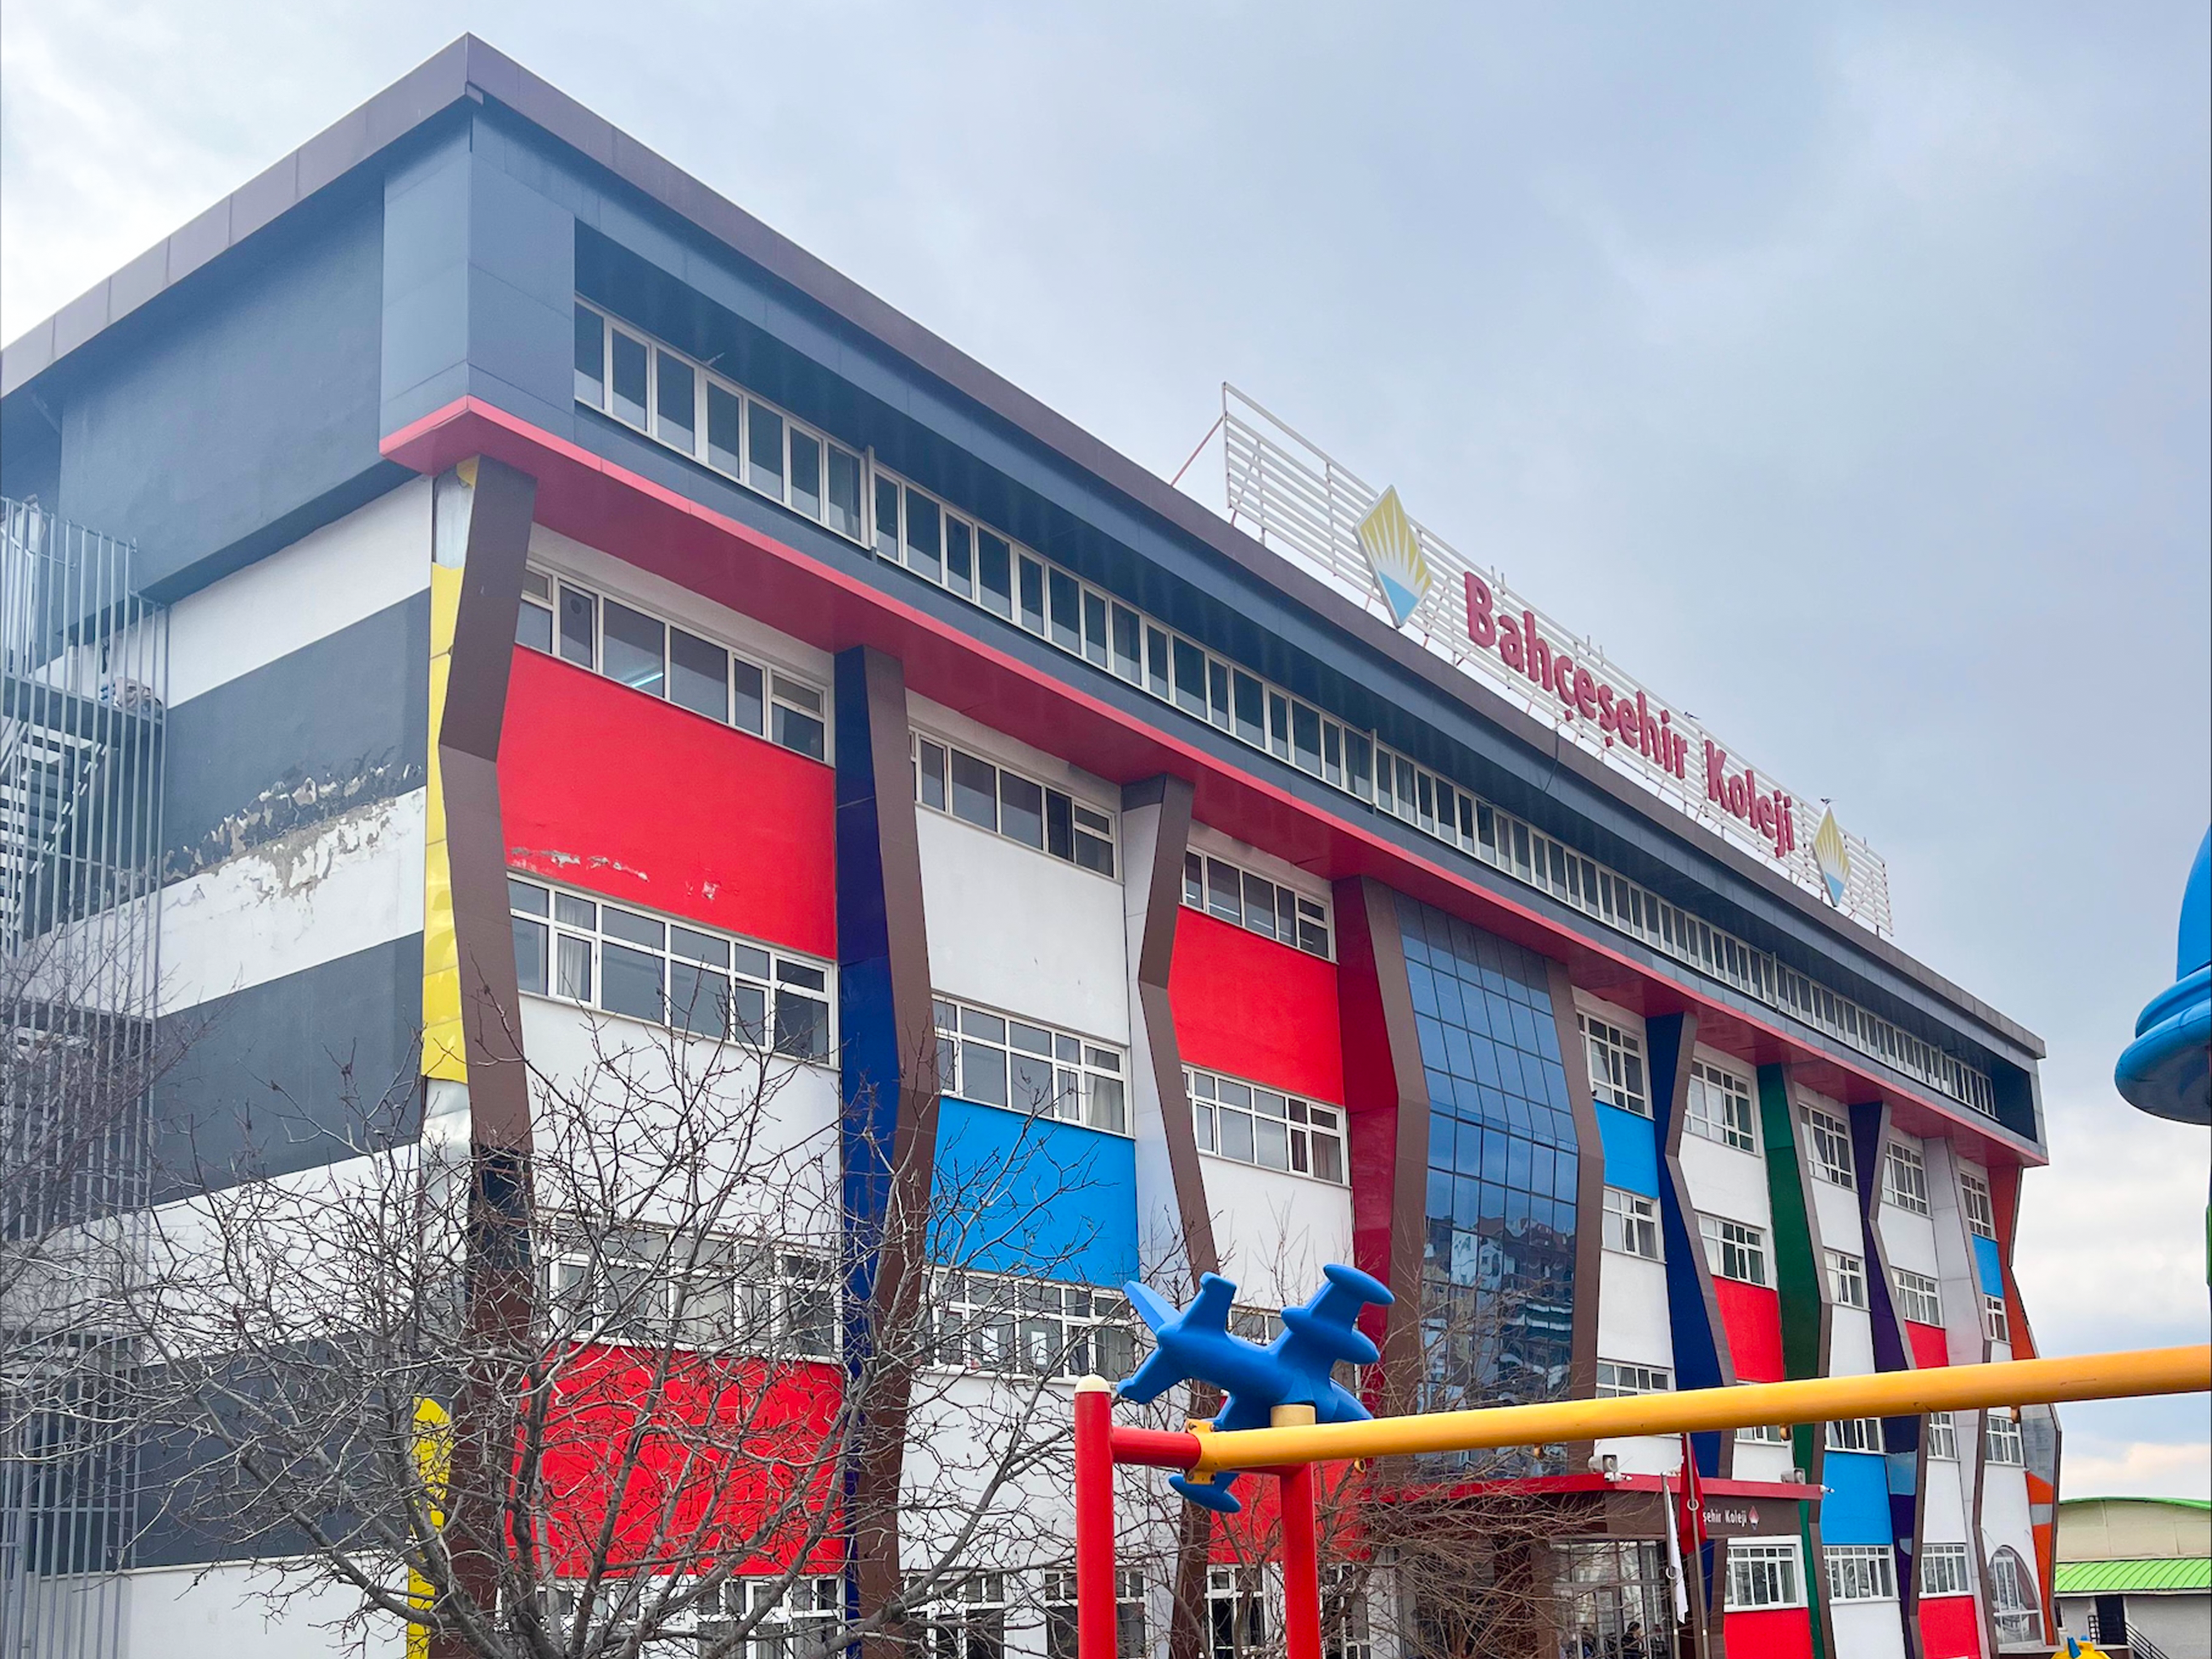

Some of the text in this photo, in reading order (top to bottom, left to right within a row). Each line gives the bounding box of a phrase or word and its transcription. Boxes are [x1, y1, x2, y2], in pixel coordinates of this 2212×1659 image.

[1464, 572, 1795, 858] Bahçeşehir Koleji
[1703, 1509, 1747, 1527] şehir Koleji
